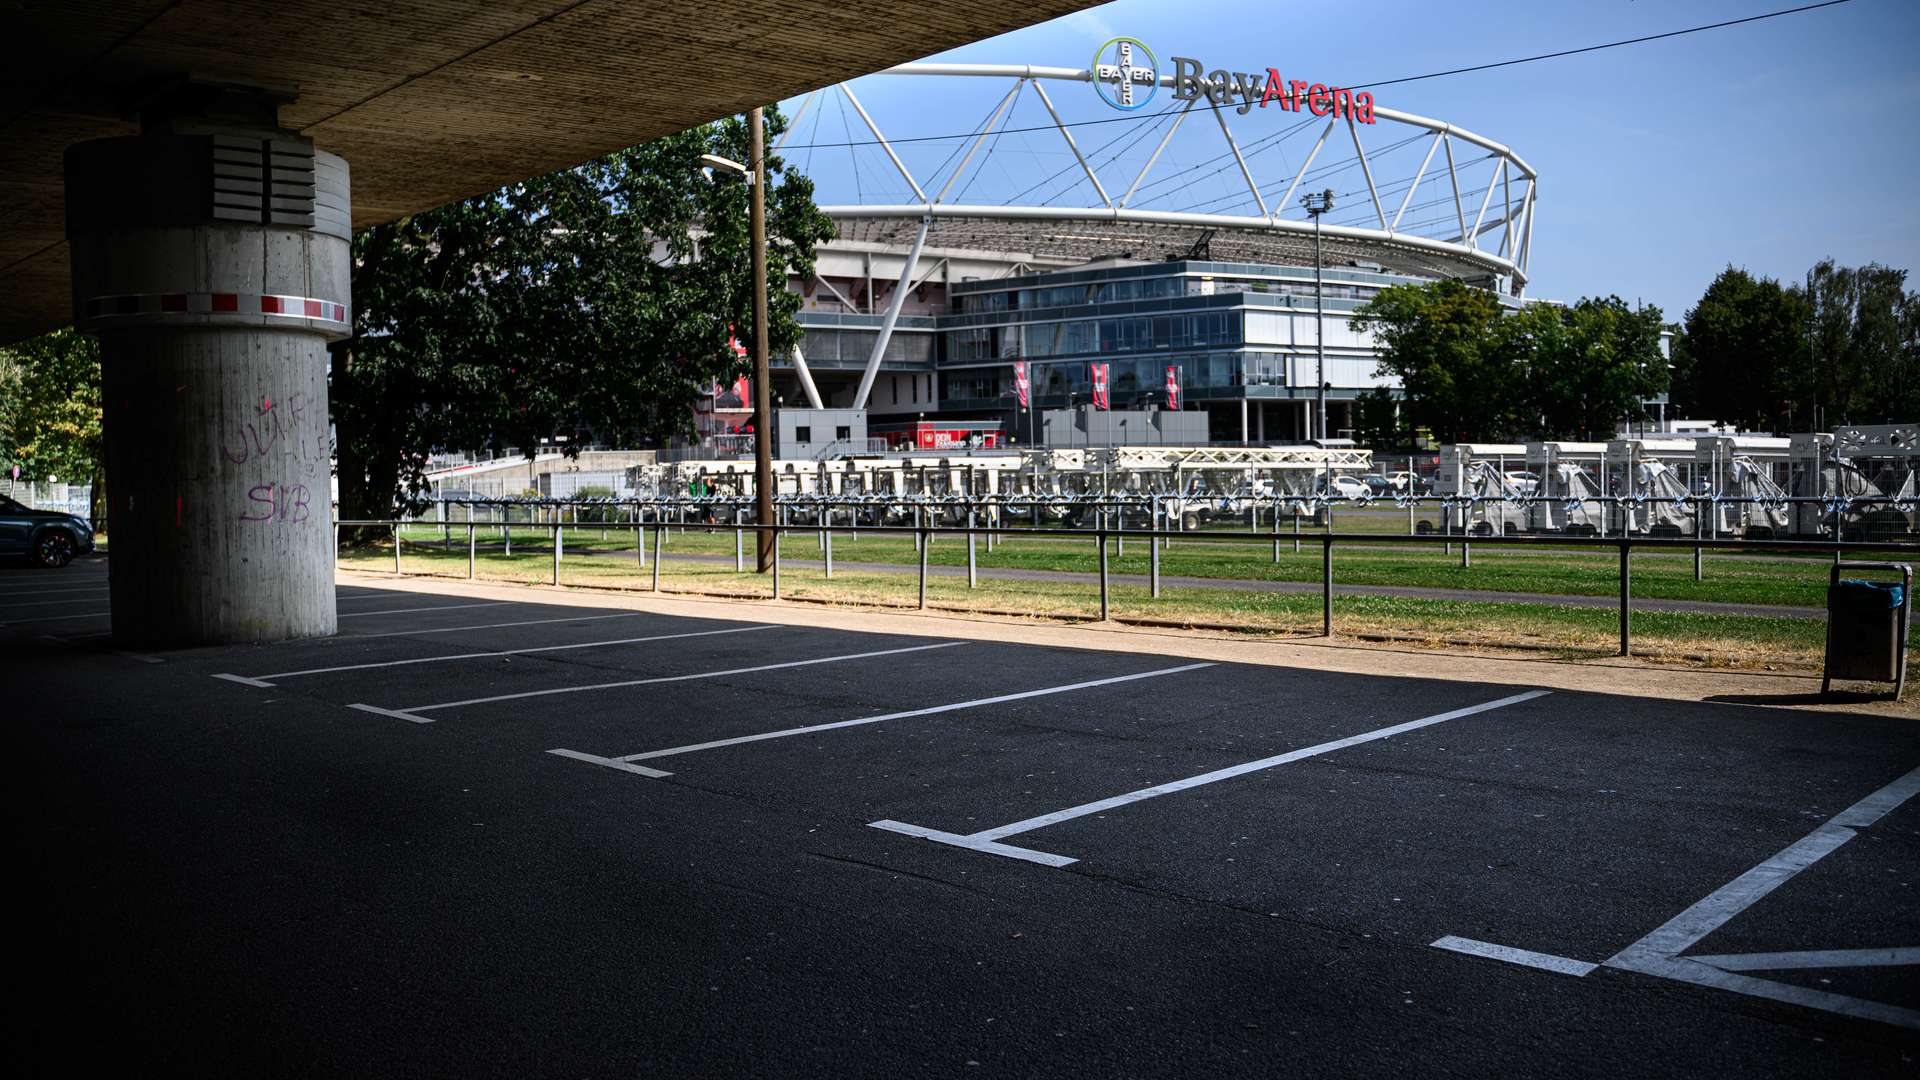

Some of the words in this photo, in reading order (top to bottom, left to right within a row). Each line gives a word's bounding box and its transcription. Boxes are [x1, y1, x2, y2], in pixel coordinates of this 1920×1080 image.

[1098, 67, 1155, 81] BAYER
[1119, 42, 1133, 105] BAYER
[1171, 56, 1376, 125] BayArena
